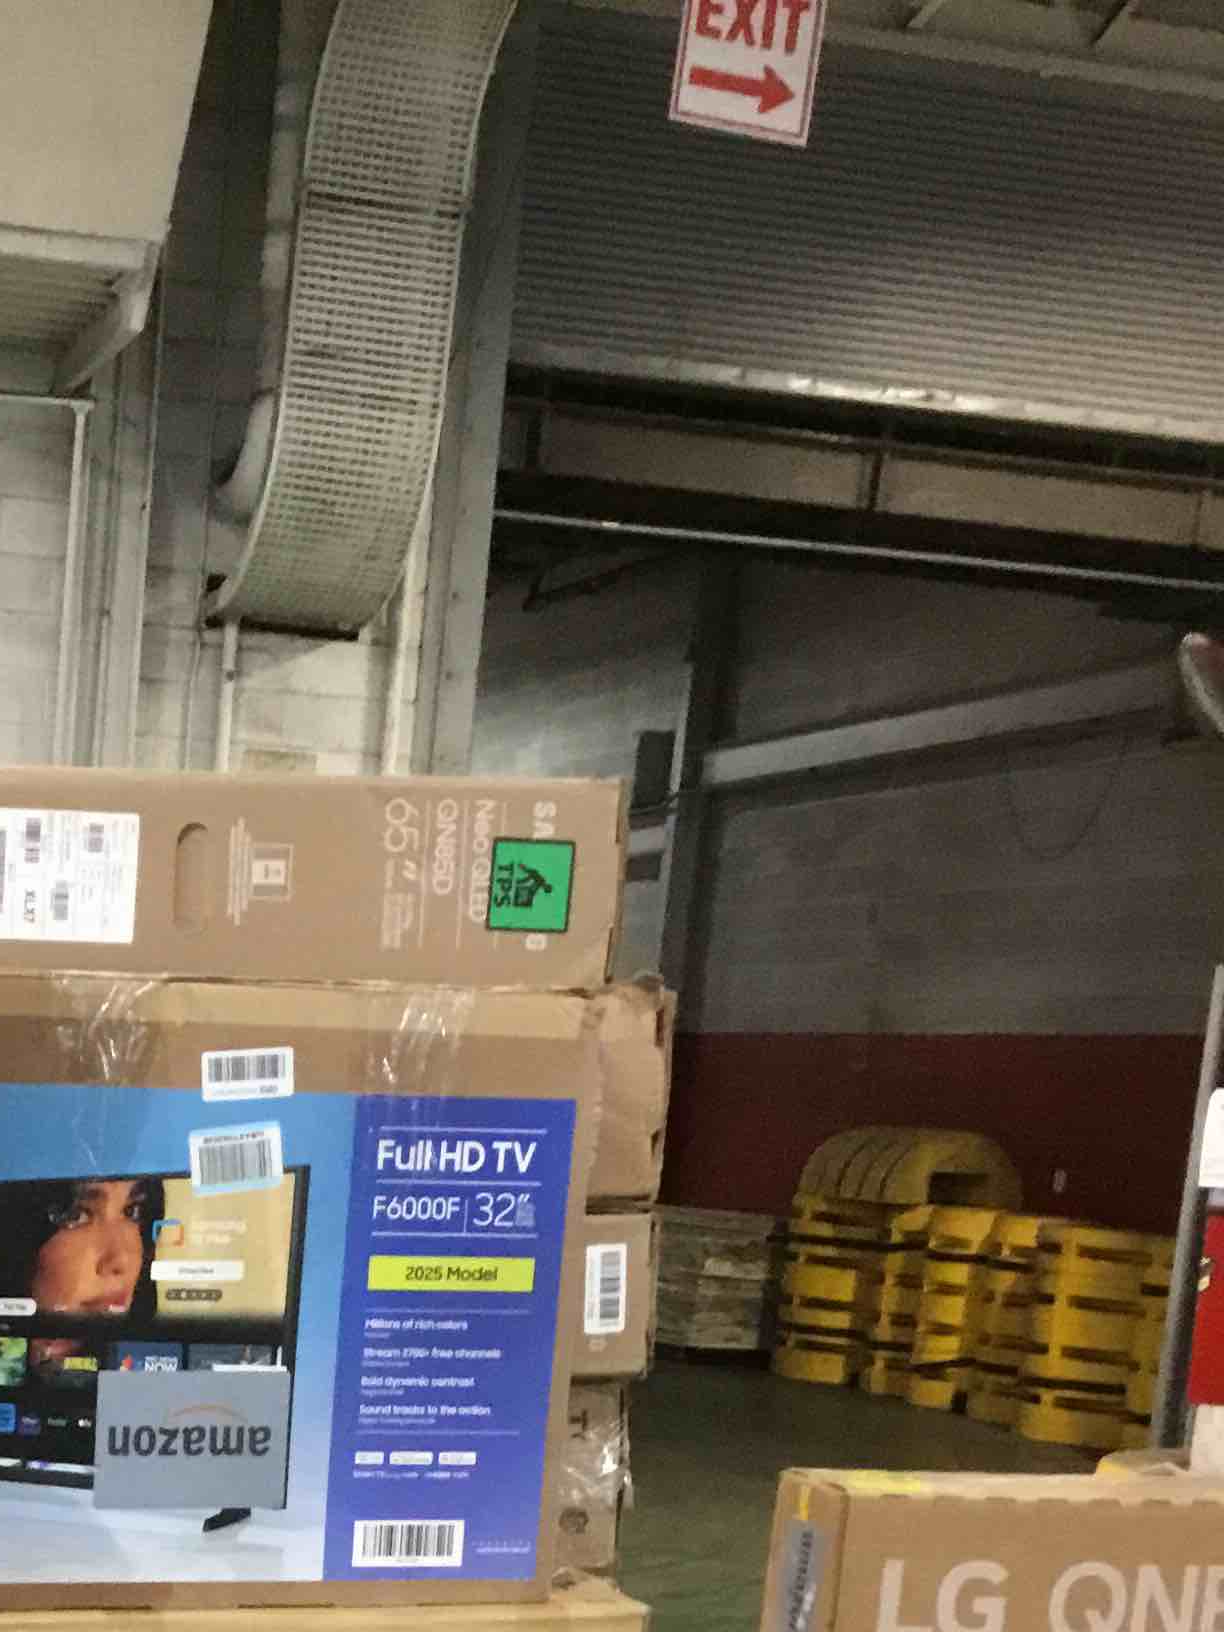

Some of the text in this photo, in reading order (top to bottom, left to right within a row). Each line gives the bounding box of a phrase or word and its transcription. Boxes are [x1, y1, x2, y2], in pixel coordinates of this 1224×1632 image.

[694, 0, 809, 56] EXIT
[495, 862, 515, 908] TPS
[377, 1139, 537, 1174] Full HD TV
[373, 1197, 460, 1222] F6000F
[405, 1264, 498, 1283] 2025 Model
[106, 1425, 272, 1459] amazon
